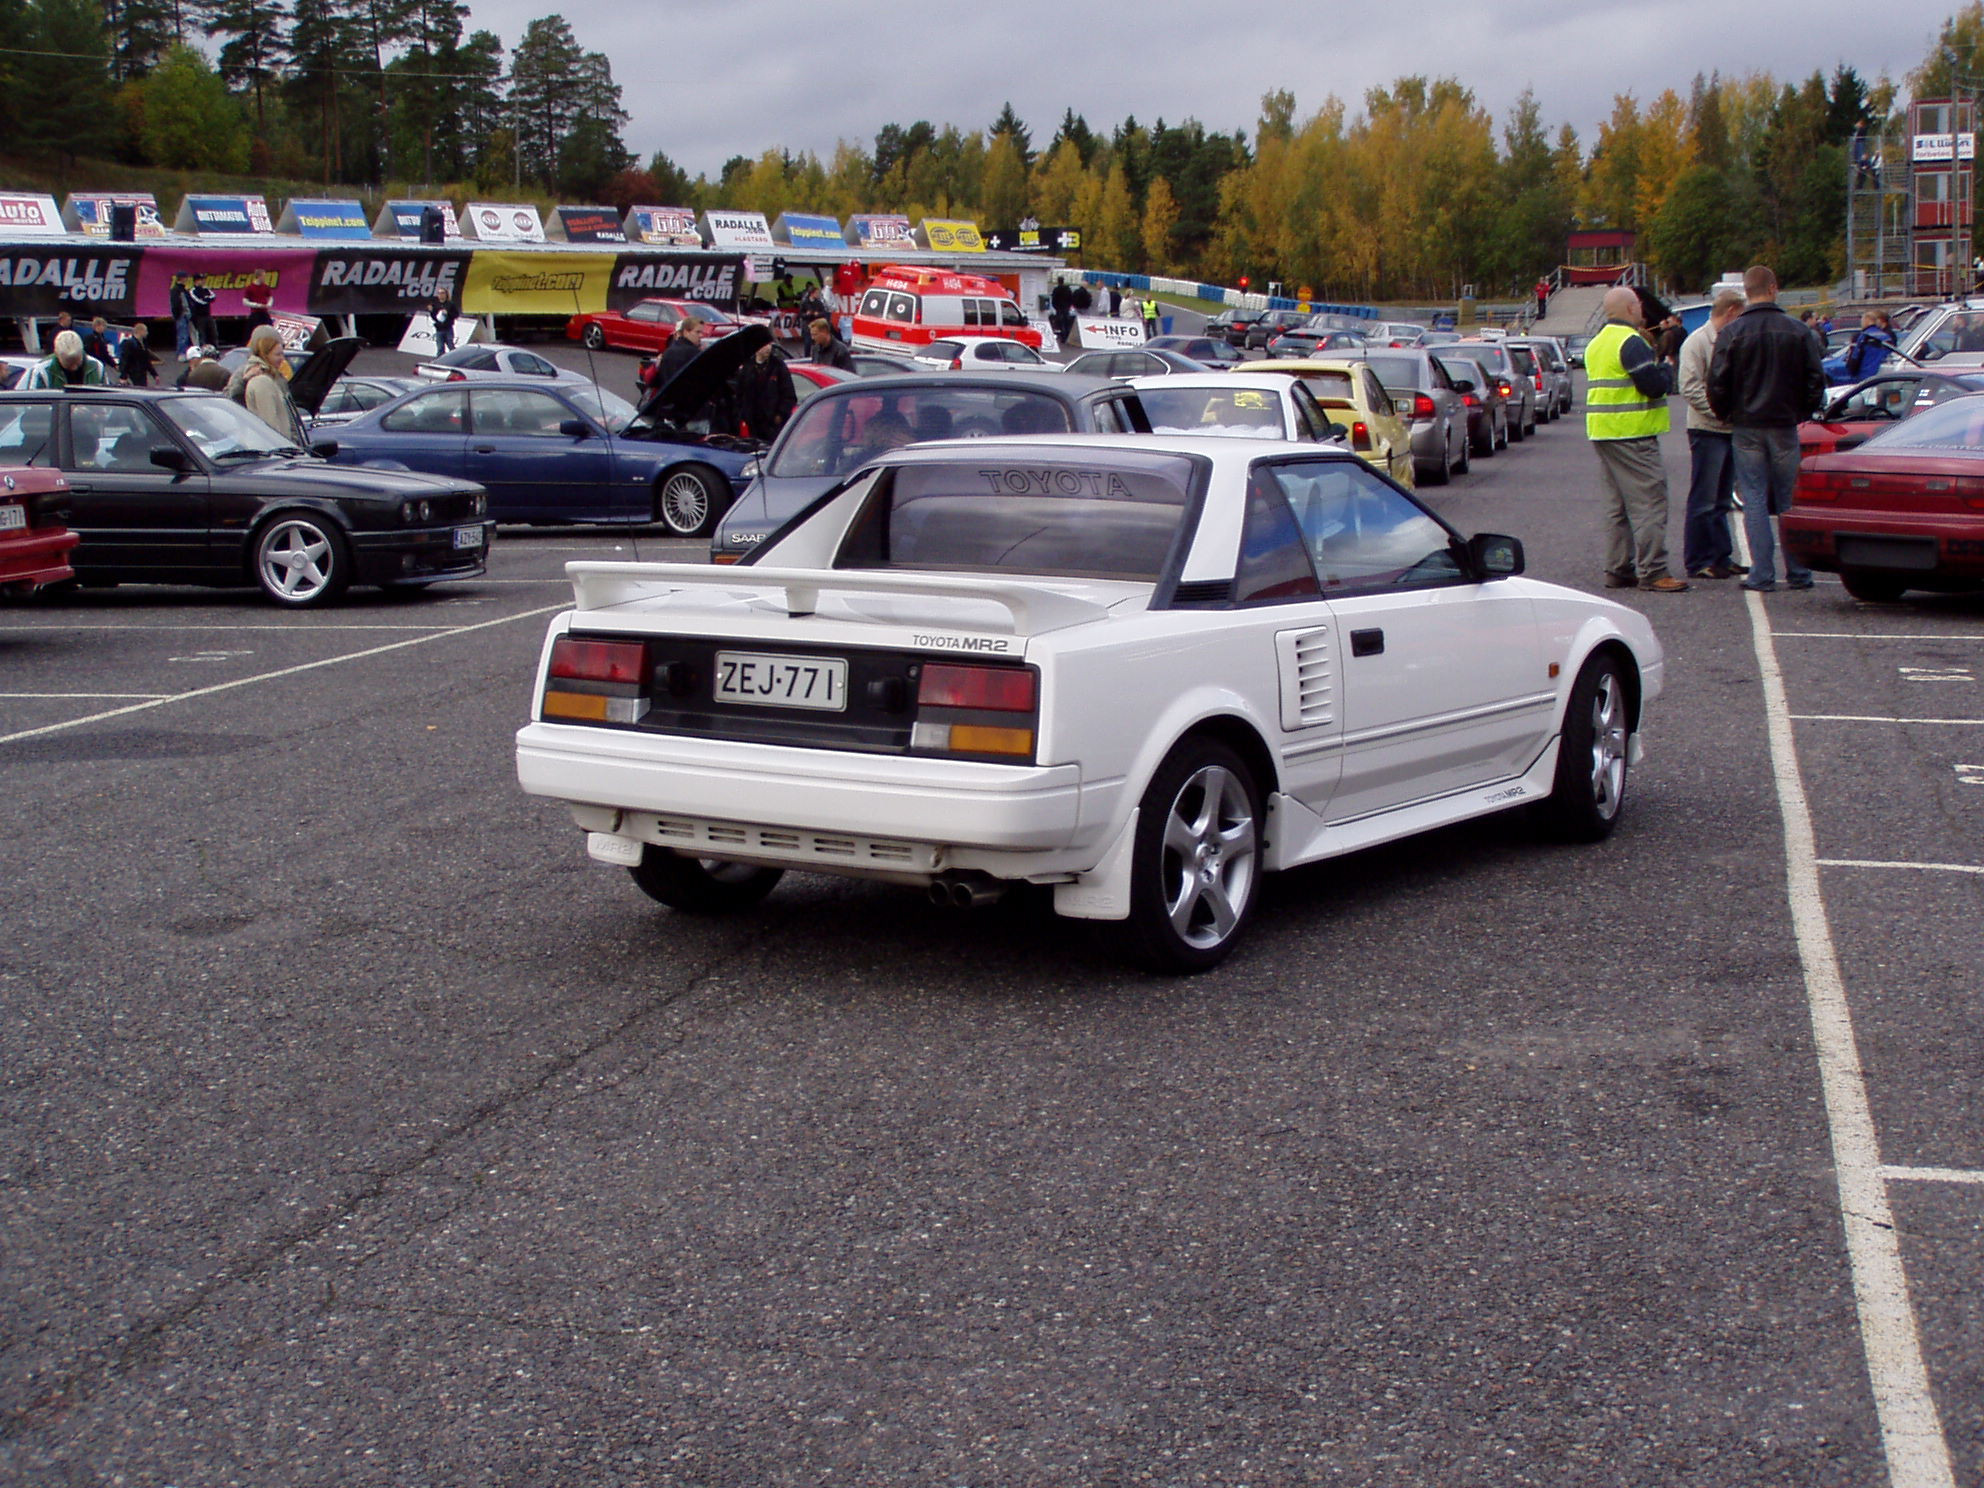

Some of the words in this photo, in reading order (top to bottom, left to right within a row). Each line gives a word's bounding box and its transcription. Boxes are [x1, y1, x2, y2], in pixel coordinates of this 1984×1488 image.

[715, 220, 763, 230] RADALLE
[321, 261, 460, 286] RADALLE
[618, 265, 736, 288] RADALLE
[59, 282, 127, 300] .com
[684, 284, 734, 300] .com
[886, 278, 909, 290] H494
[1103, 325, 1139, 337] INFO
[979, 469, 1133, 498] TOYOTA
[912, 634, 960, 649] TOYOTA
[961, 636, 1009, 653] MR2
